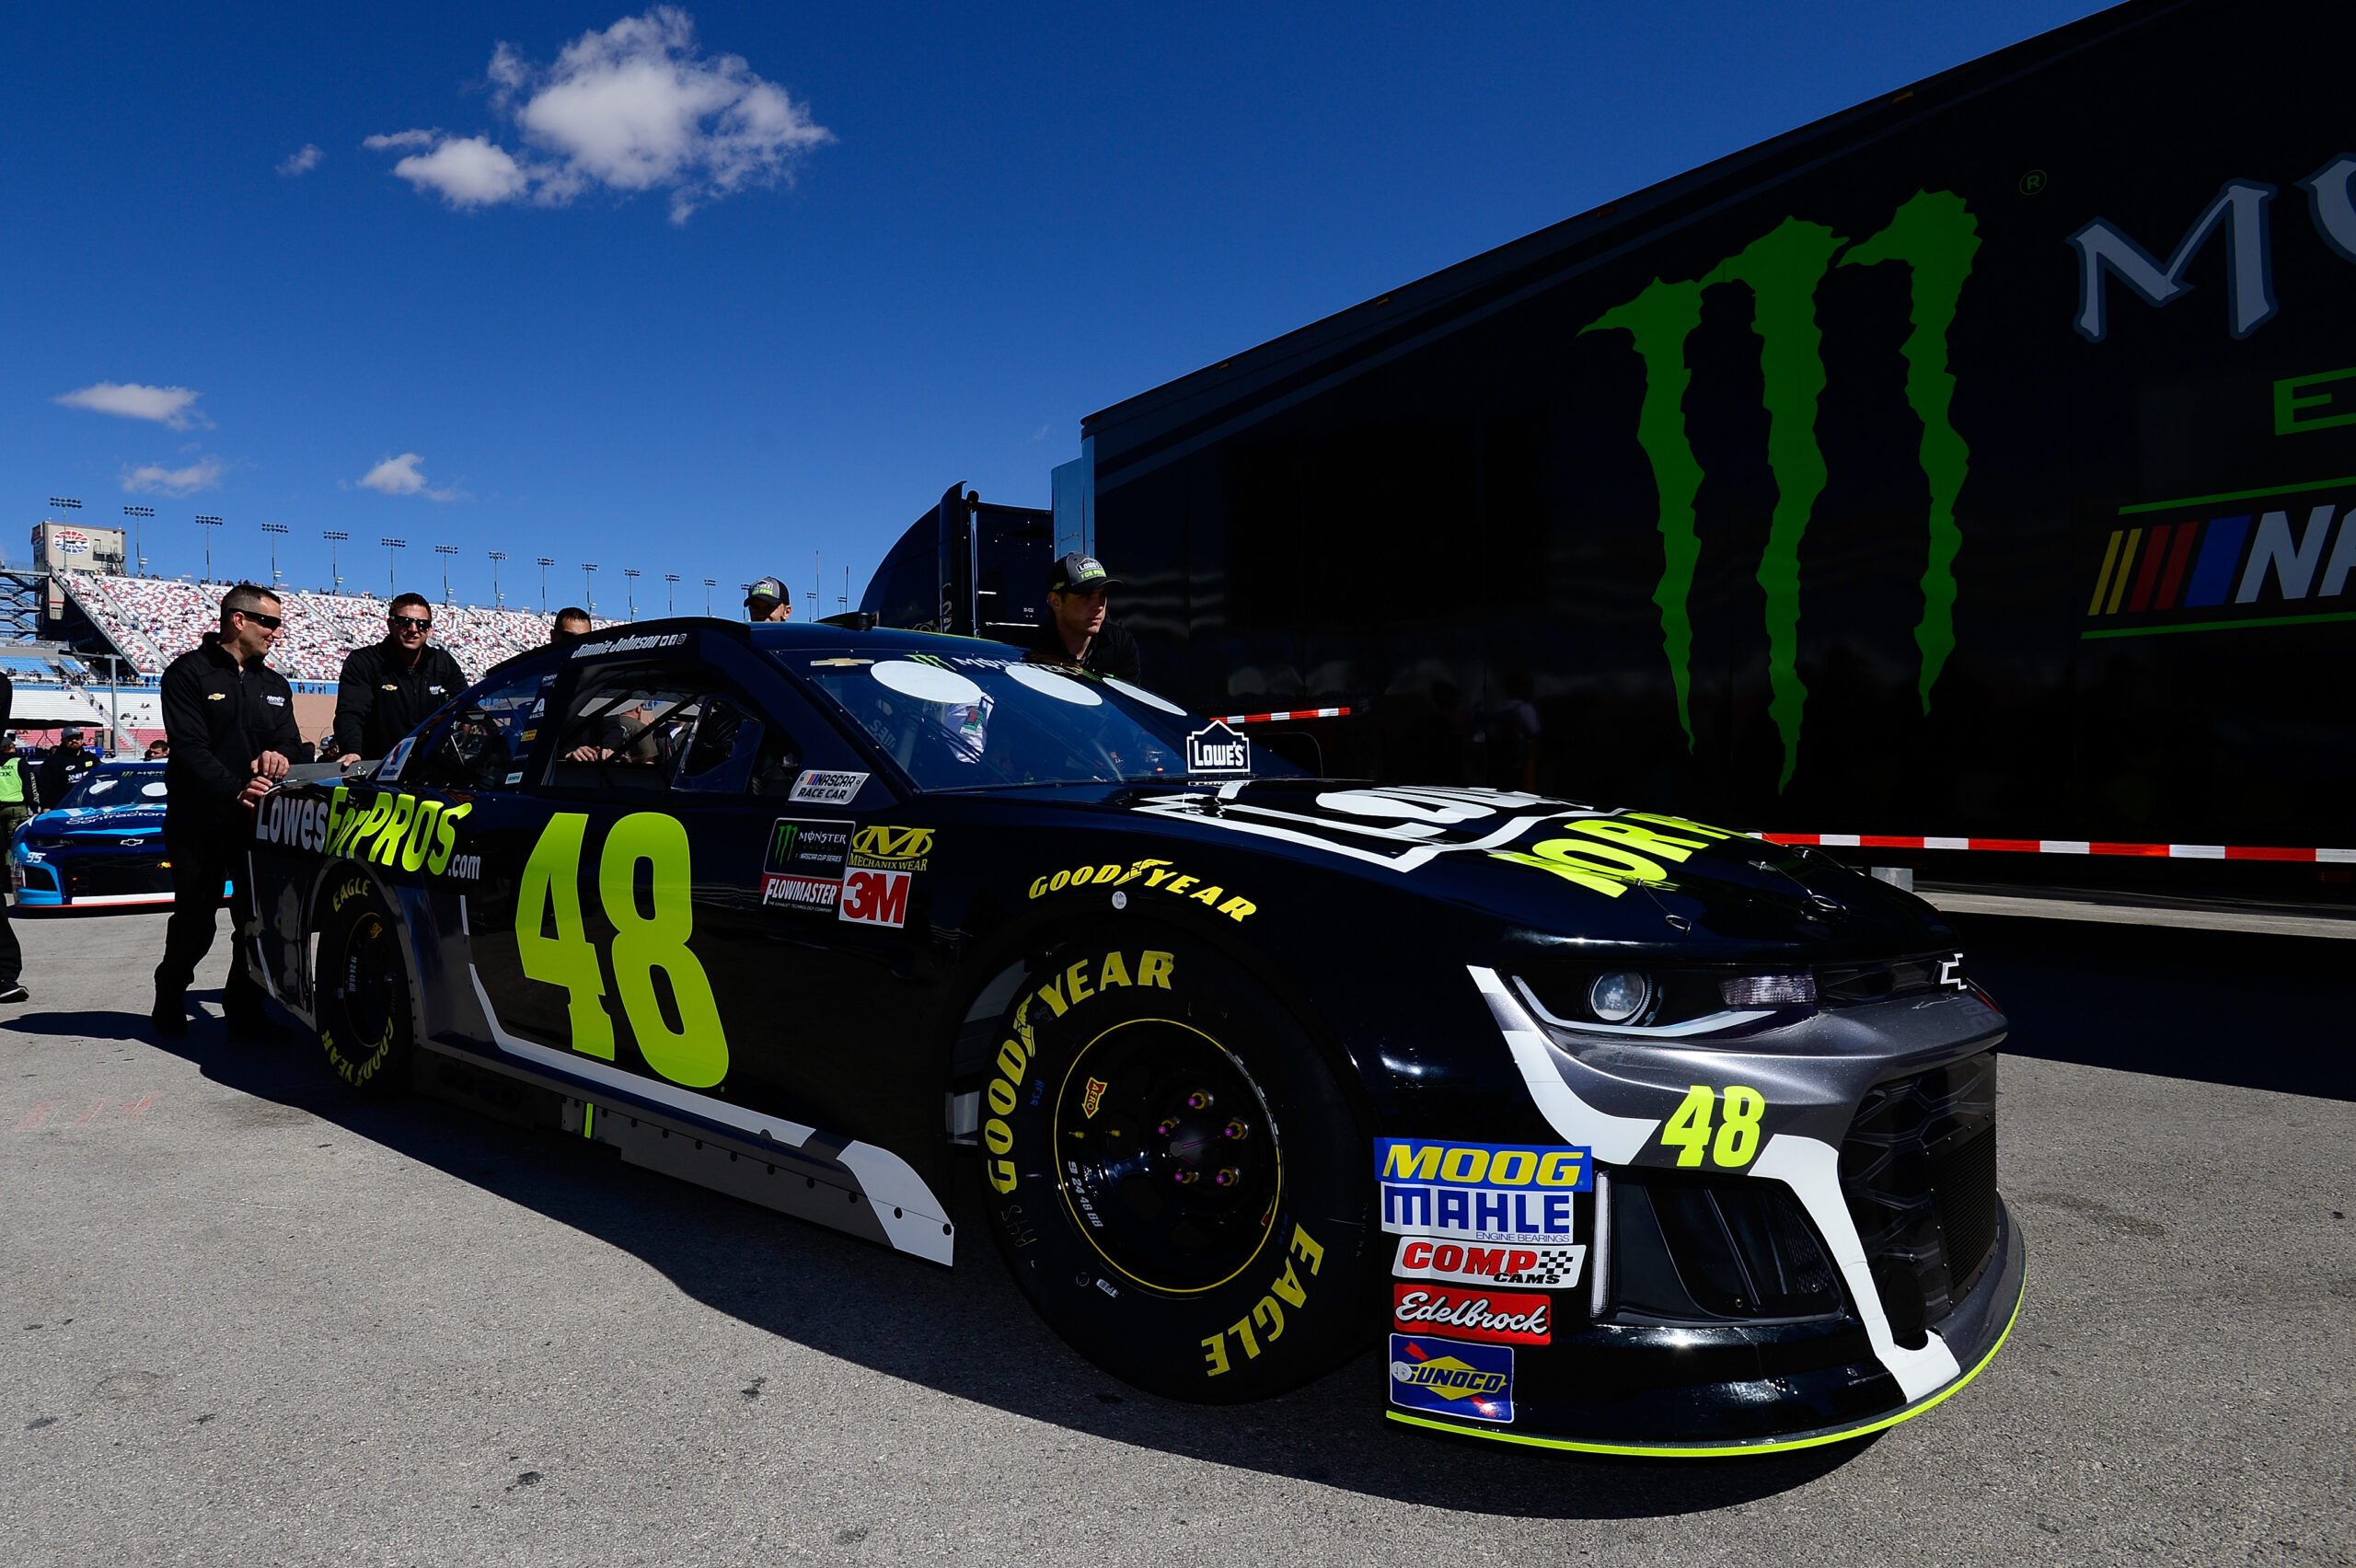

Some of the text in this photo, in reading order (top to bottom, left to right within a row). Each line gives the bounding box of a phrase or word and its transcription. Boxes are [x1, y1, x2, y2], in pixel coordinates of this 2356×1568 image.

[572, 635, 660, 659] Jimmie Johnson
[1195, 741, 1245, 767] LOWE'S
[798, 788, 847, 800] RACE CAR
[816, 774, 857, 788] NASCAR
[798, 830, 847, 845] MONSTER
[26, 852, 47, 864] 95
[849, 853, 928, 871] MECHANIX WEAR
[332, 877, 371, 913] EAGLE
[763, 879, 837, 905] FLOWMASTER
[843, 871, 910, 924] 3M
[515, 812, 730, 1088] 48
[1660, 1085, 1766, 1168] 48
[1382, 1145, 1584, 1186] MOOG
[1071, 1178, 1086, 1193] 24
[1080, 1196, 1093, 1211] 48
[1384, 1185, 1570, 1233] MAHLE
[1086, 1212, 1103, 1227] 88
[1475, 1232, 1570, 1243] ENGINE BEARINGS
[1402, 1242, 1539, 1276] COMP
[1493, 1272, 1562, 1285] CAMS
[1200, 1222, 1325, 1378] EAGLE
[1395, 1291, 1548, 1334] Edelbrock
[1407, 1365, 1506, 1392] SUNOCO
